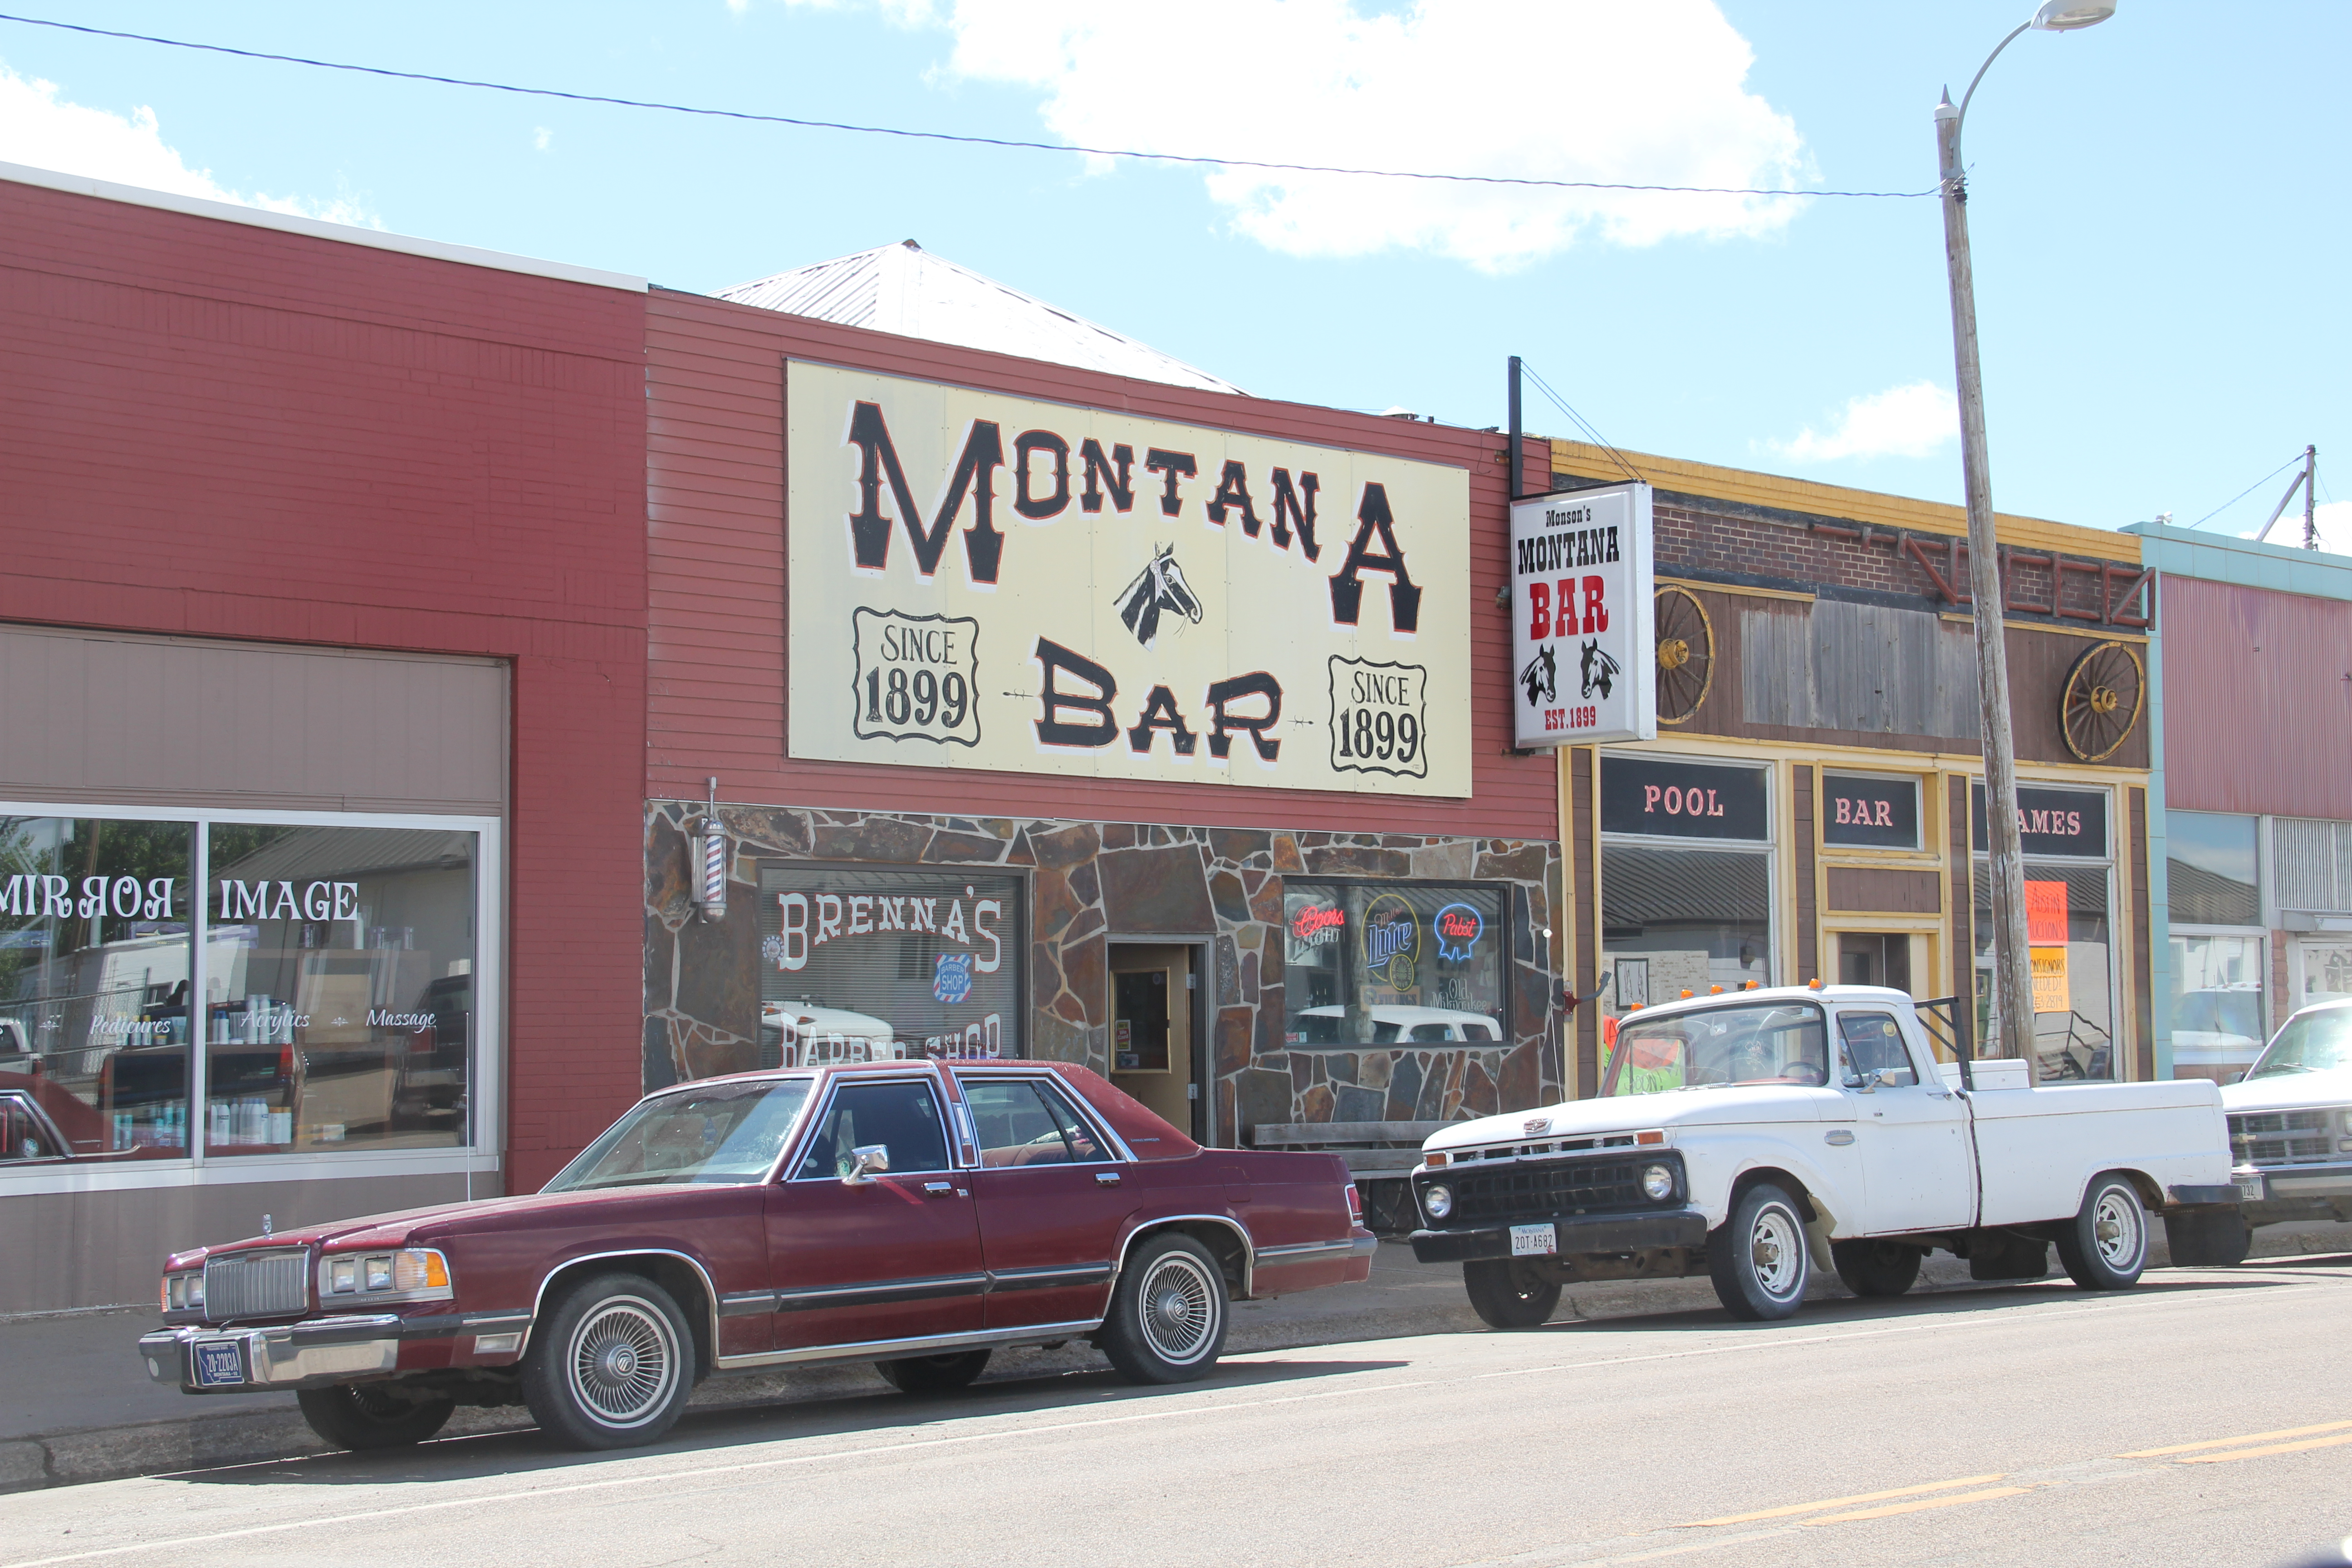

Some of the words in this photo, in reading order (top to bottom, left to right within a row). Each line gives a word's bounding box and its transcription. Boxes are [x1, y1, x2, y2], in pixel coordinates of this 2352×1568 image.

[843, 400, 1424, 634] MONTANA
[1545, 505, 1591, 528] Monson's
[1518, 525, 1619, 575] MONTANA
[1529, 575, 1609, 640] BAR
[881, 624, 957, 665] SINCE
[866, 666, 967, 728] 1899
[1030, 635, 1284, 763] BAR
[1351, 671, 1410, 707] SINCE
[1544, 706, 1597, 730] EST.1899
[1340, 709, 1418, 760] 1899
[1644, 785, 1724, 817] POOL
[1834, 798, 1893, 827] BAR
[2017, 808, 2081, 836] AMES
[220, 879, 359, 921] IMAGE
[2031, 885, 2060, 914] AUSTIN
[777, 885, 1002, 974] BRENNA'S
[1291, 906, 1345, 937] Coors
[1374, 906, 1403, 927] Miller
[1443, 913, 1477, 937] Pabst
[2026, 911, 2065, 940] AUCTIONS
[1367, 921, 1412, 968] Lite
[941, 964, 965, 975] BARBER
[2030, 958, 2066, 975] ONSIGNORS
[942, 975, 963, 990] SHOP
[1449, 978, 1470, 1000] Old
[2033, 995, 2063, 1009] 63-2879
[89, 1014, 171, 1035] Pedicures
[240, 1009, 310, 1036] Acrylics
[366, 1009, 436, 1034] Massage
[2242, 1185, 2254, 1196] 732
